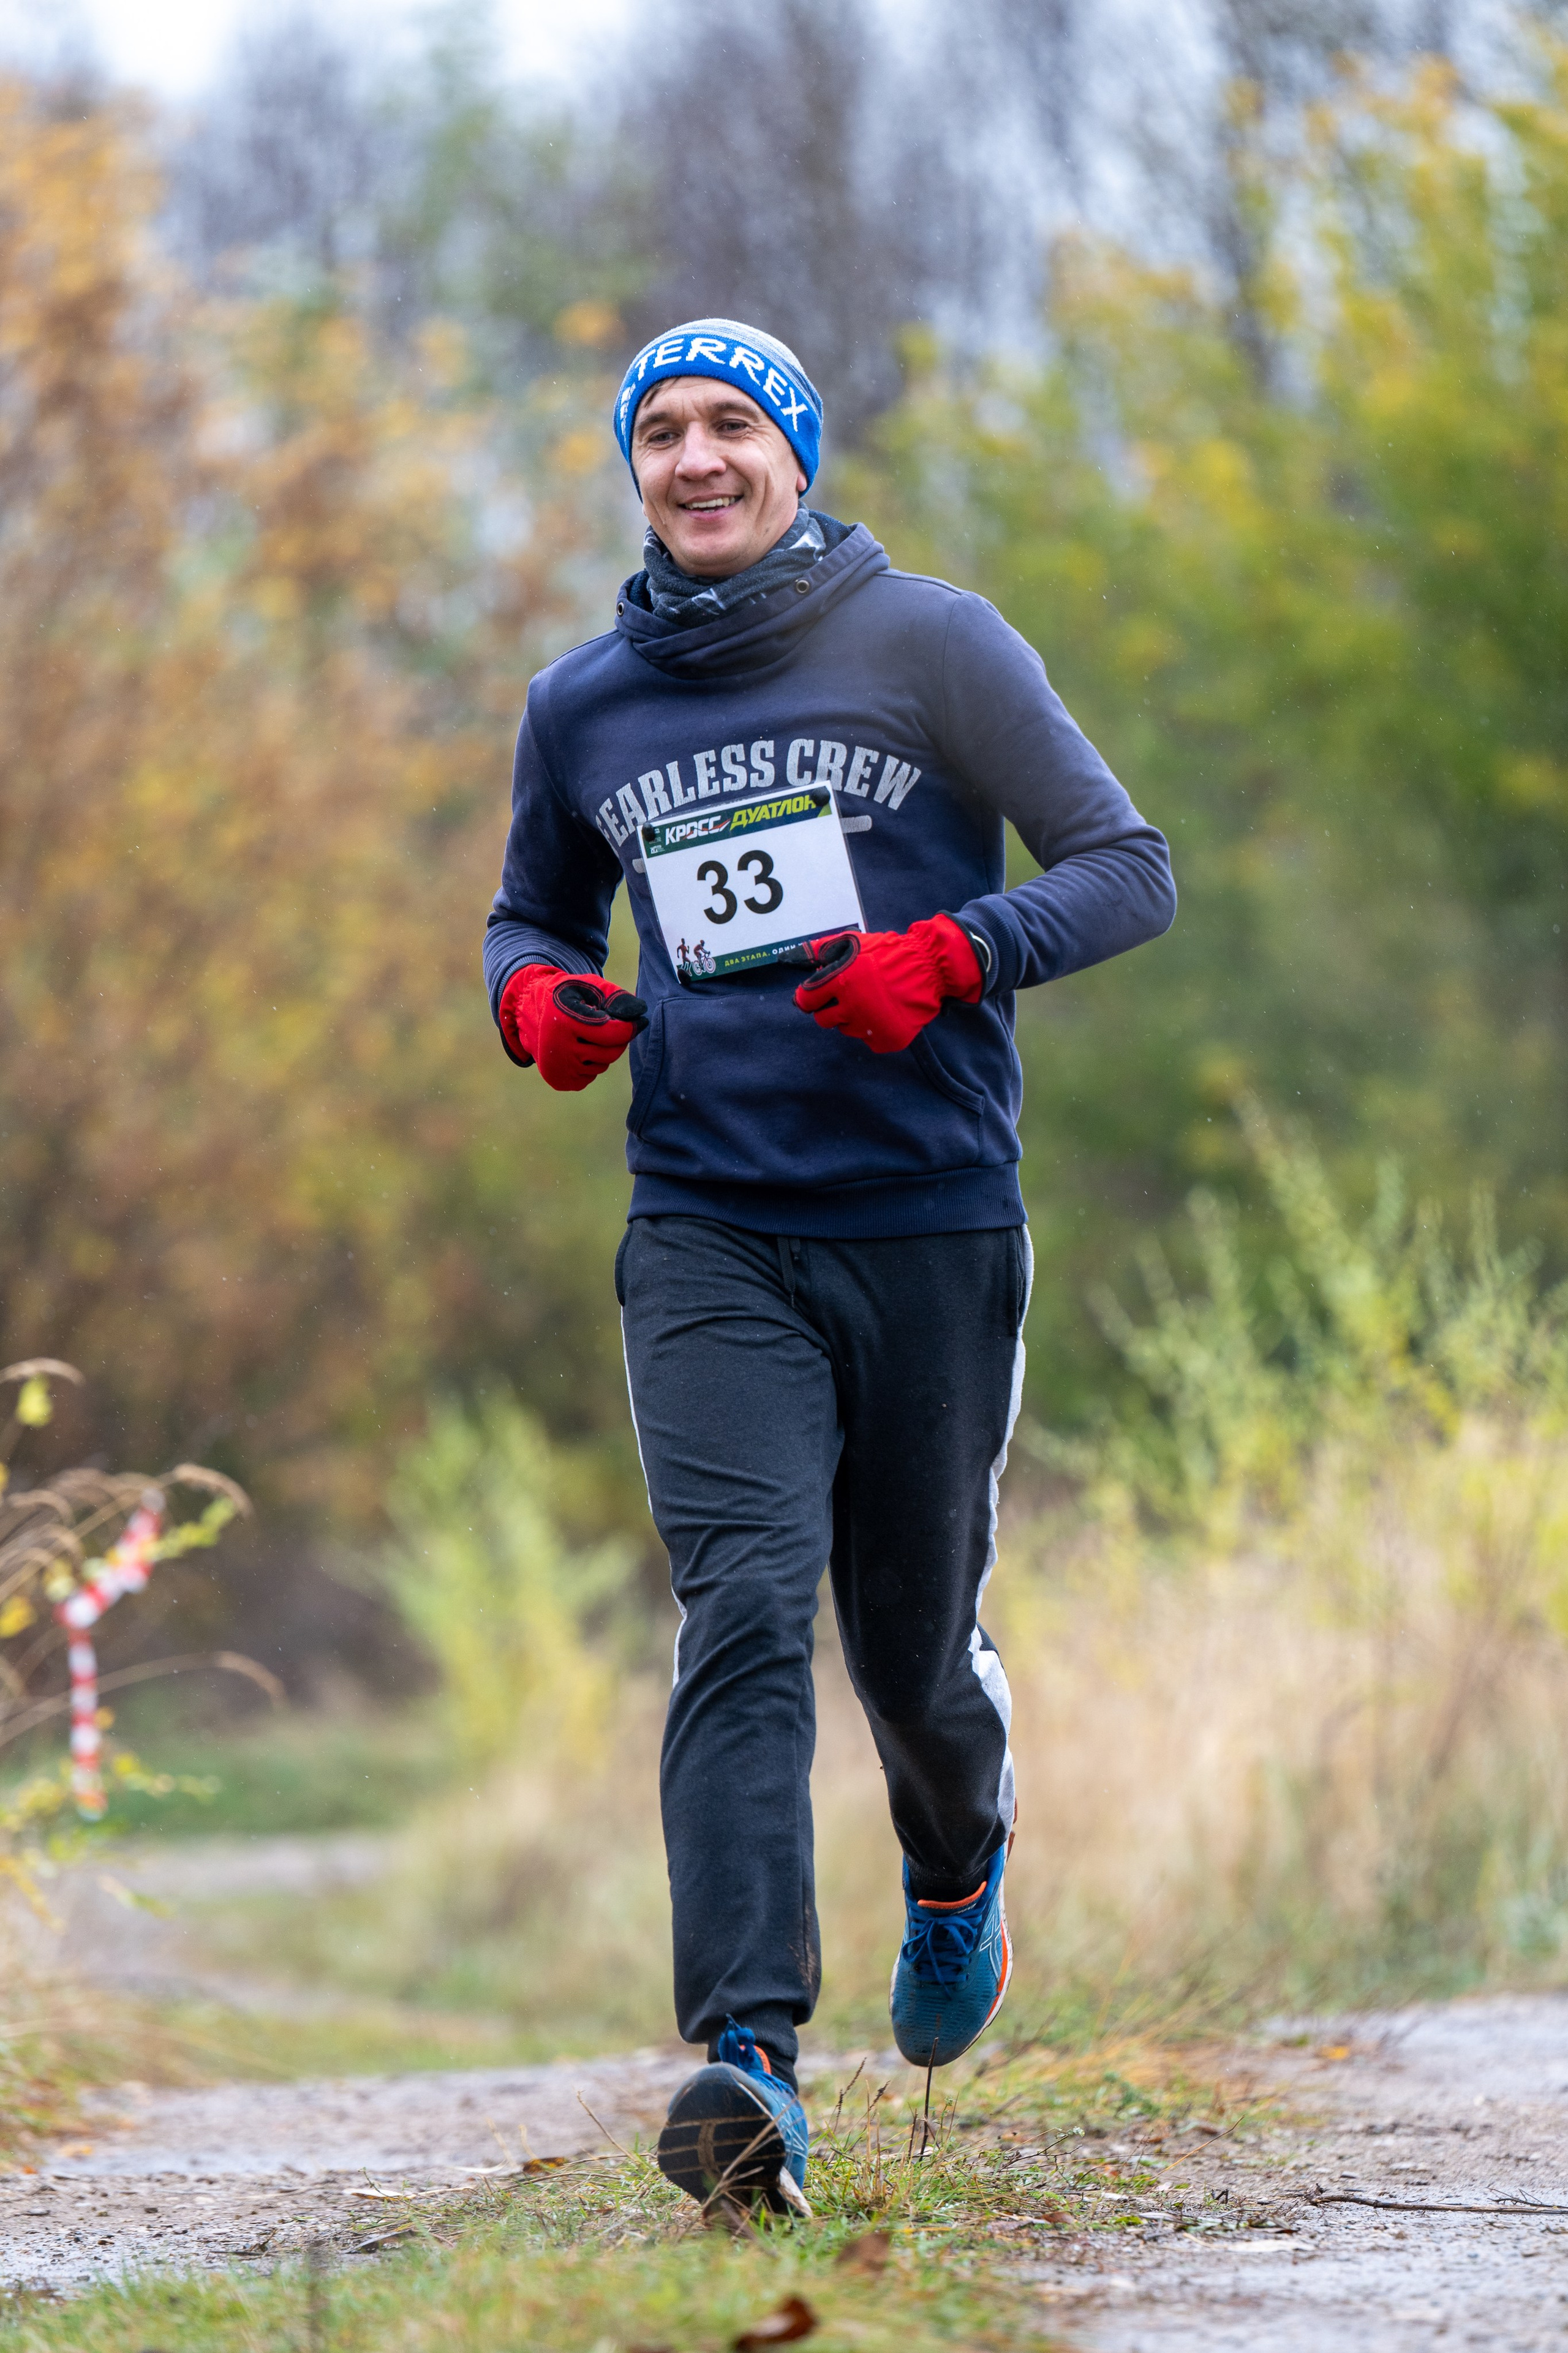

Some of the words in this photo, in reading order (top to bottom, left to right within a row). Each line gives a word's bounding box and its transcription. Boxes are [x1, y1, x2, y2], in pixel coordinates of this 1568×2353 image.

[635, 337, 809, 432] TERREX
[786, 739, 921, 810] CREW
[665, 815, 723, 846] КРОСС
[730, 795, 816, 831] ДУАТЛОН
[696, 849, 783, 924] 33
[725, 958, 739, 967] ДВА
[741, 952, 771, 962] ЭТАПА.
